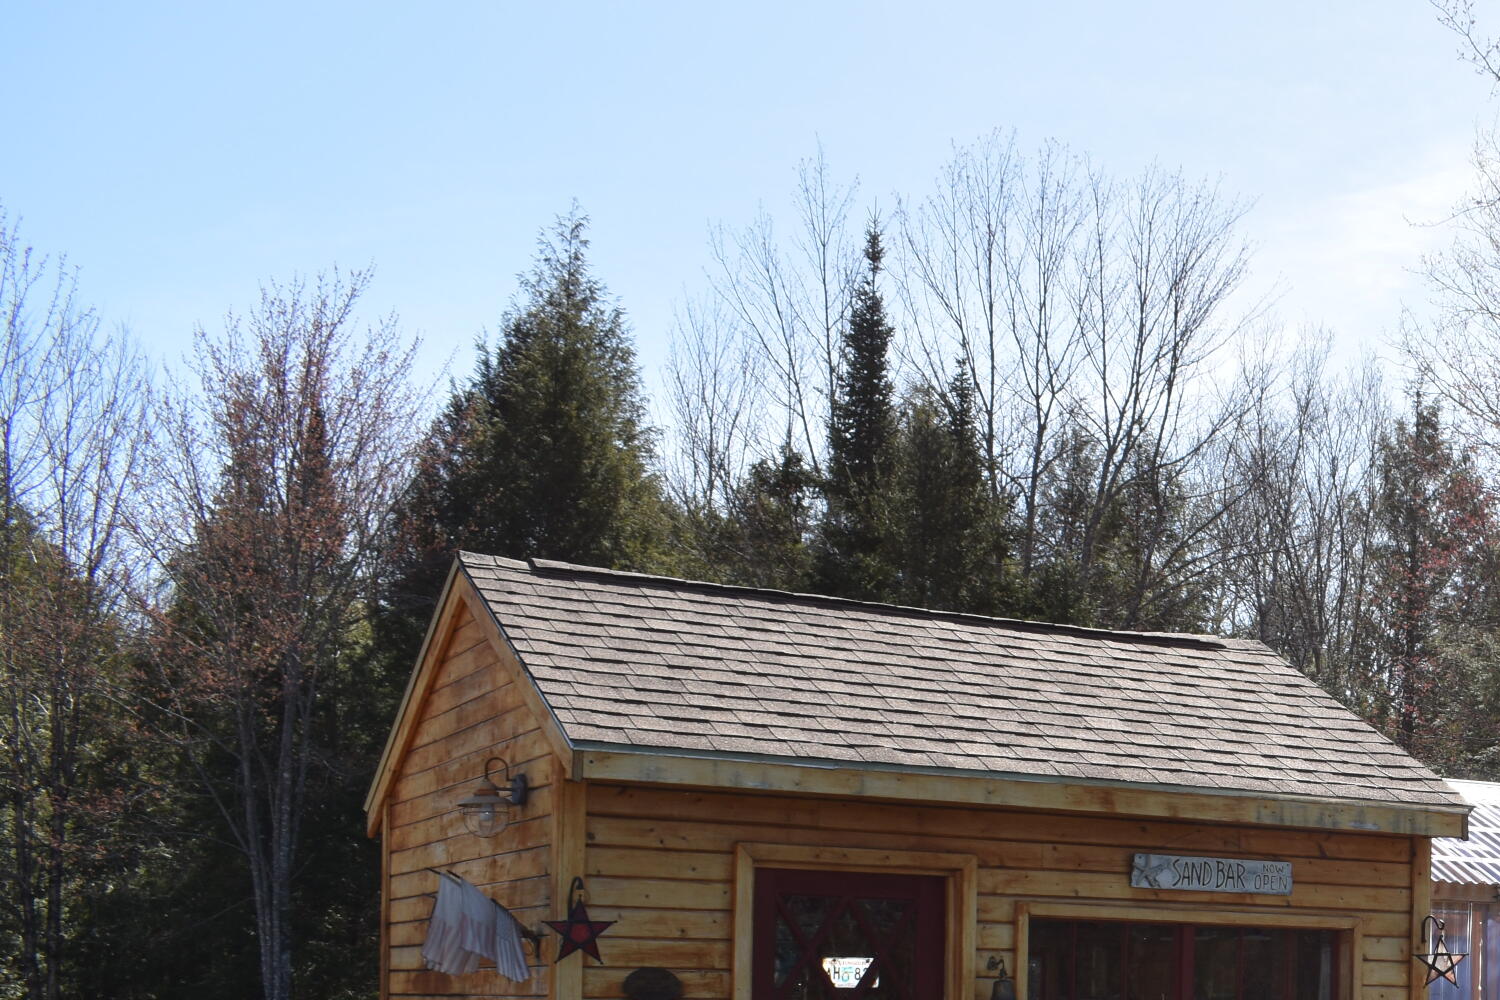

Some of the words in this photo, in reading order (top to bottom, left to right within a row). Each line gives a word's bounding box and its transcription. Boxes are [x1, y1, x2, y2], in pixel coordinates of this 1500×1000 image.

[1172, 858, 1213, 887] SAND
[1215, 860, 1246, 889] BAR
[1262, 863, 1285, 874] NOW
[1254, 874, 1288, 891] OPEN
